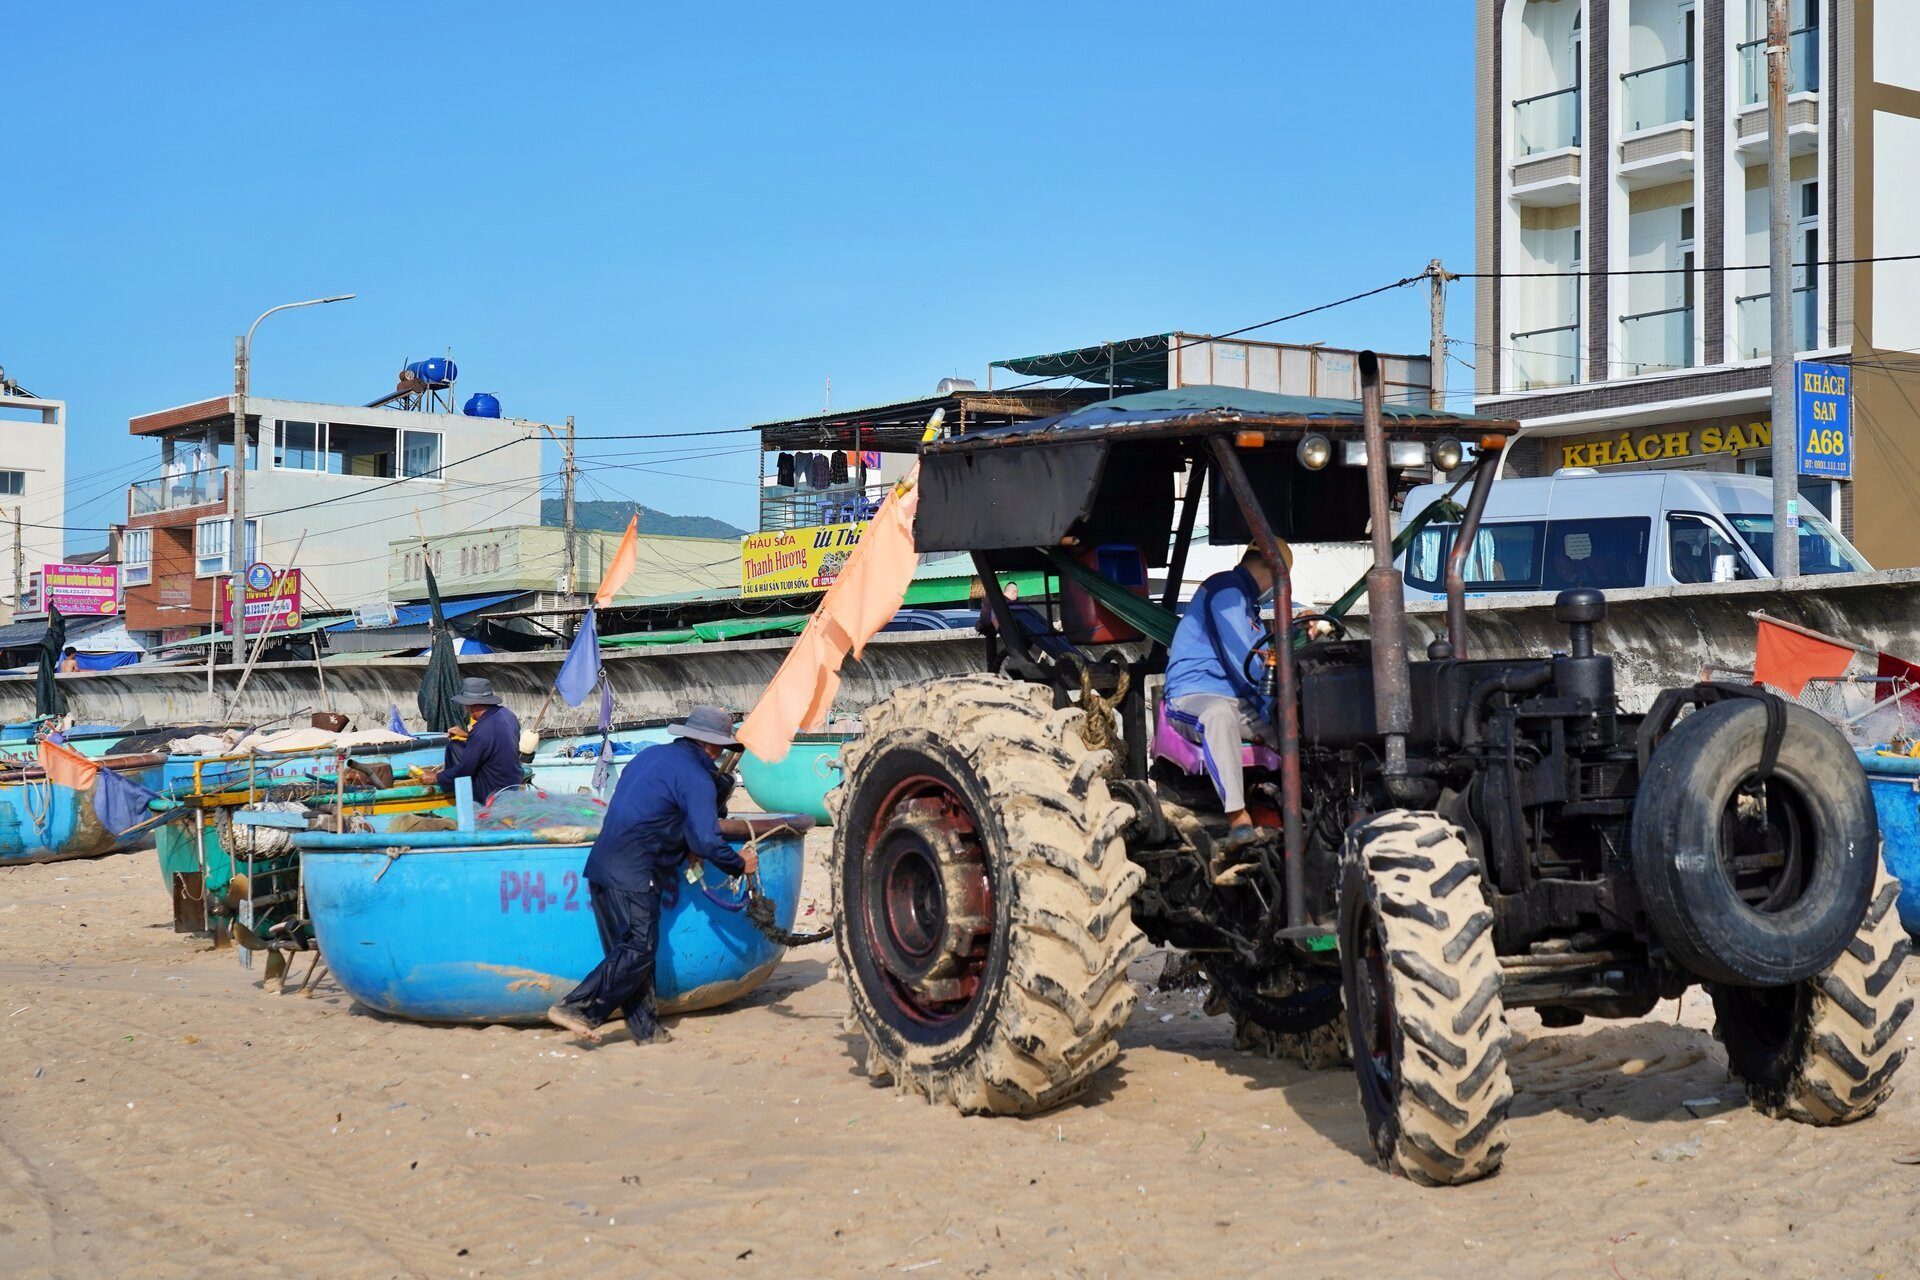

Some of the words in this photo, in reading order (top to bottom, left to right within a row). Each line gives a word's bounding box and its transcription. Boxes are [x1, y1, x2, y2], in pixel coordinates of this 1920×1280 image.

[1804, 370, 1846, 396] KHÁCH
[1813, 400, 1837, 425] SẠN
[1562, 431, 1690, 469] KHÁCH
[1700, 420, 1773, 458] SẠN
[1806, 428, 1845, 456] A68
[749, 537, 772, 550] HÀU
[745, 554, 774, 579] Thanh
[775, 548, 808, 569] Hương
